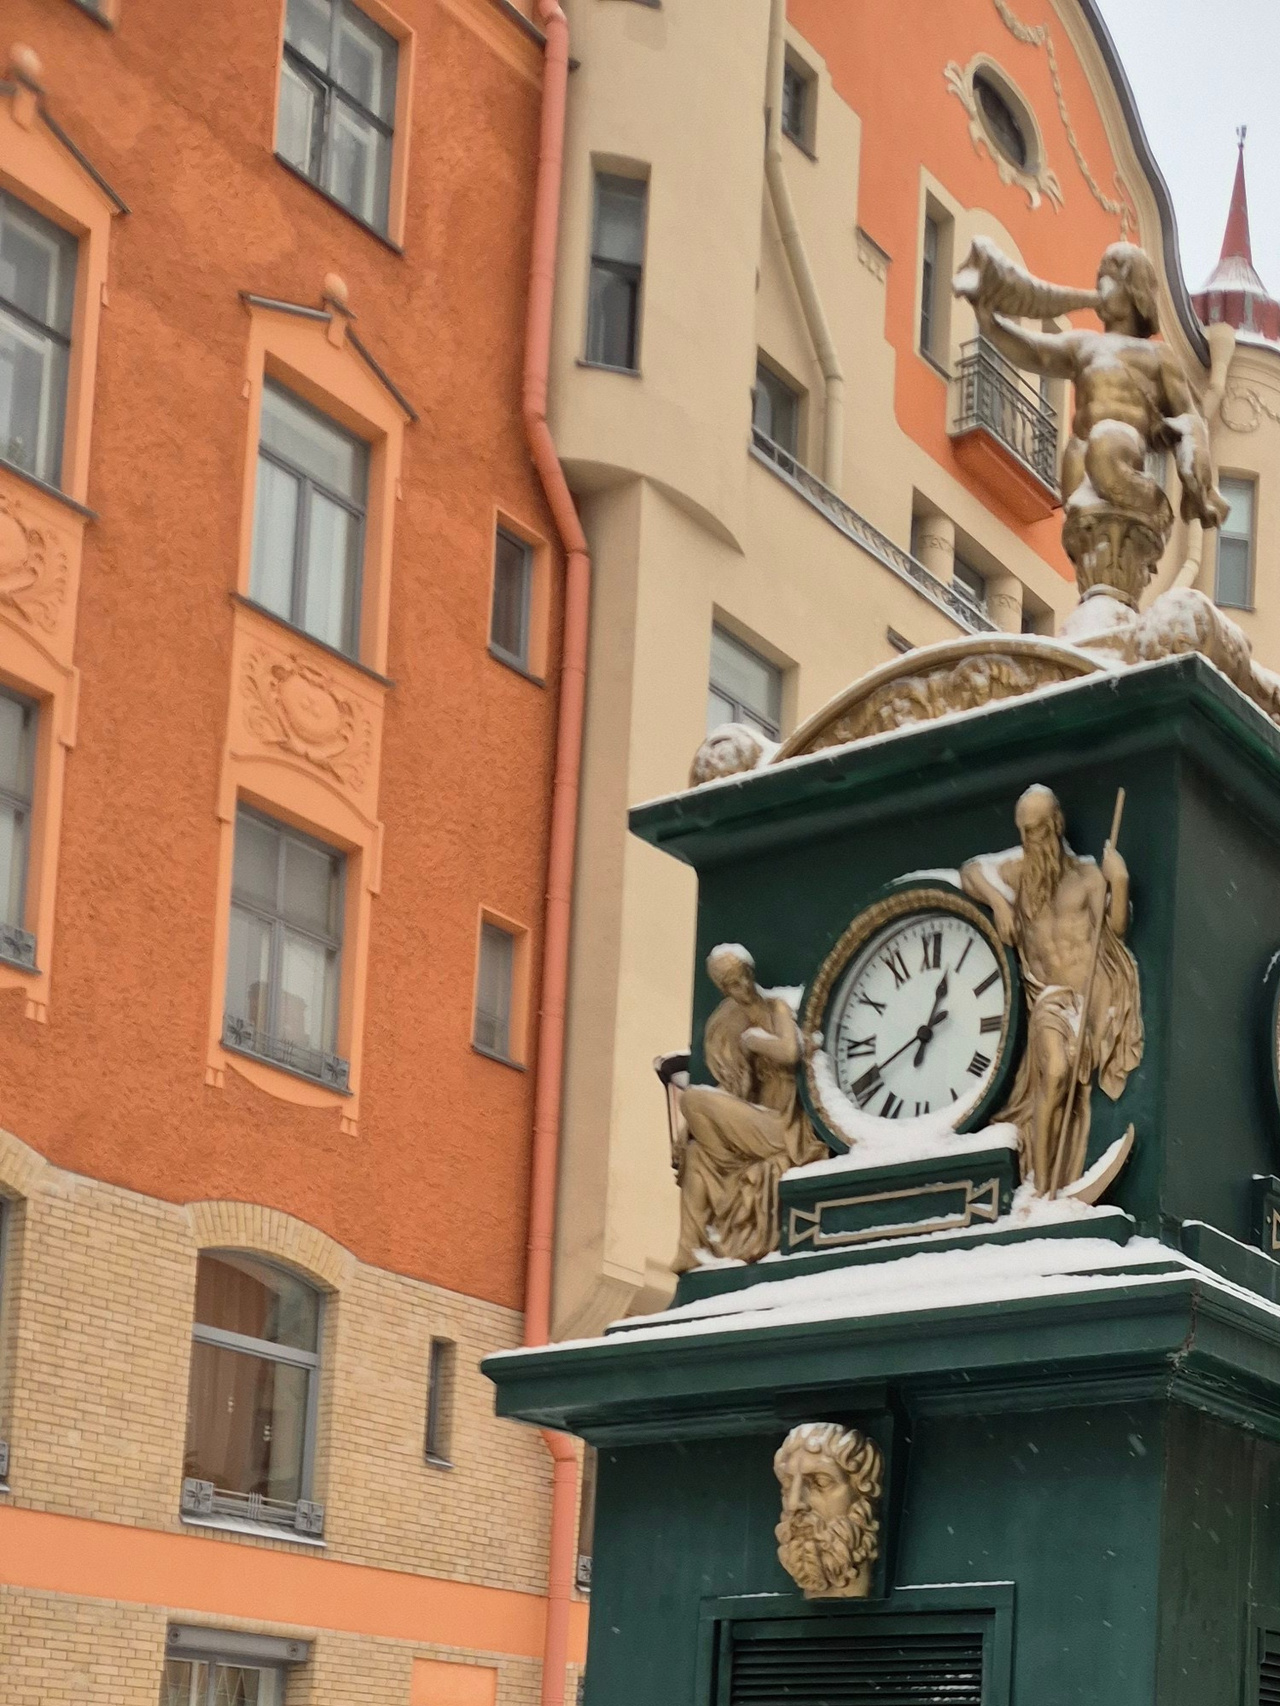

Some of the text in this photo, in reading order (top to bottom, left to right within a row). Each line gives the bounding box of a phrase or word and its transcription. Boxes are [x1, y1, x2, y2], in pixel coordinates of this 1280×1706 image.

[921, 932, 943, 972] XII
[954, 937, 974, 974] I
[880, 946, 910, 991] XI
[972, 968, 1001, 999] II
[860, 991, 887, 1017] X
[980, 1015, 1003, 1034] III
[846, 1034, 876, 1059] IX
